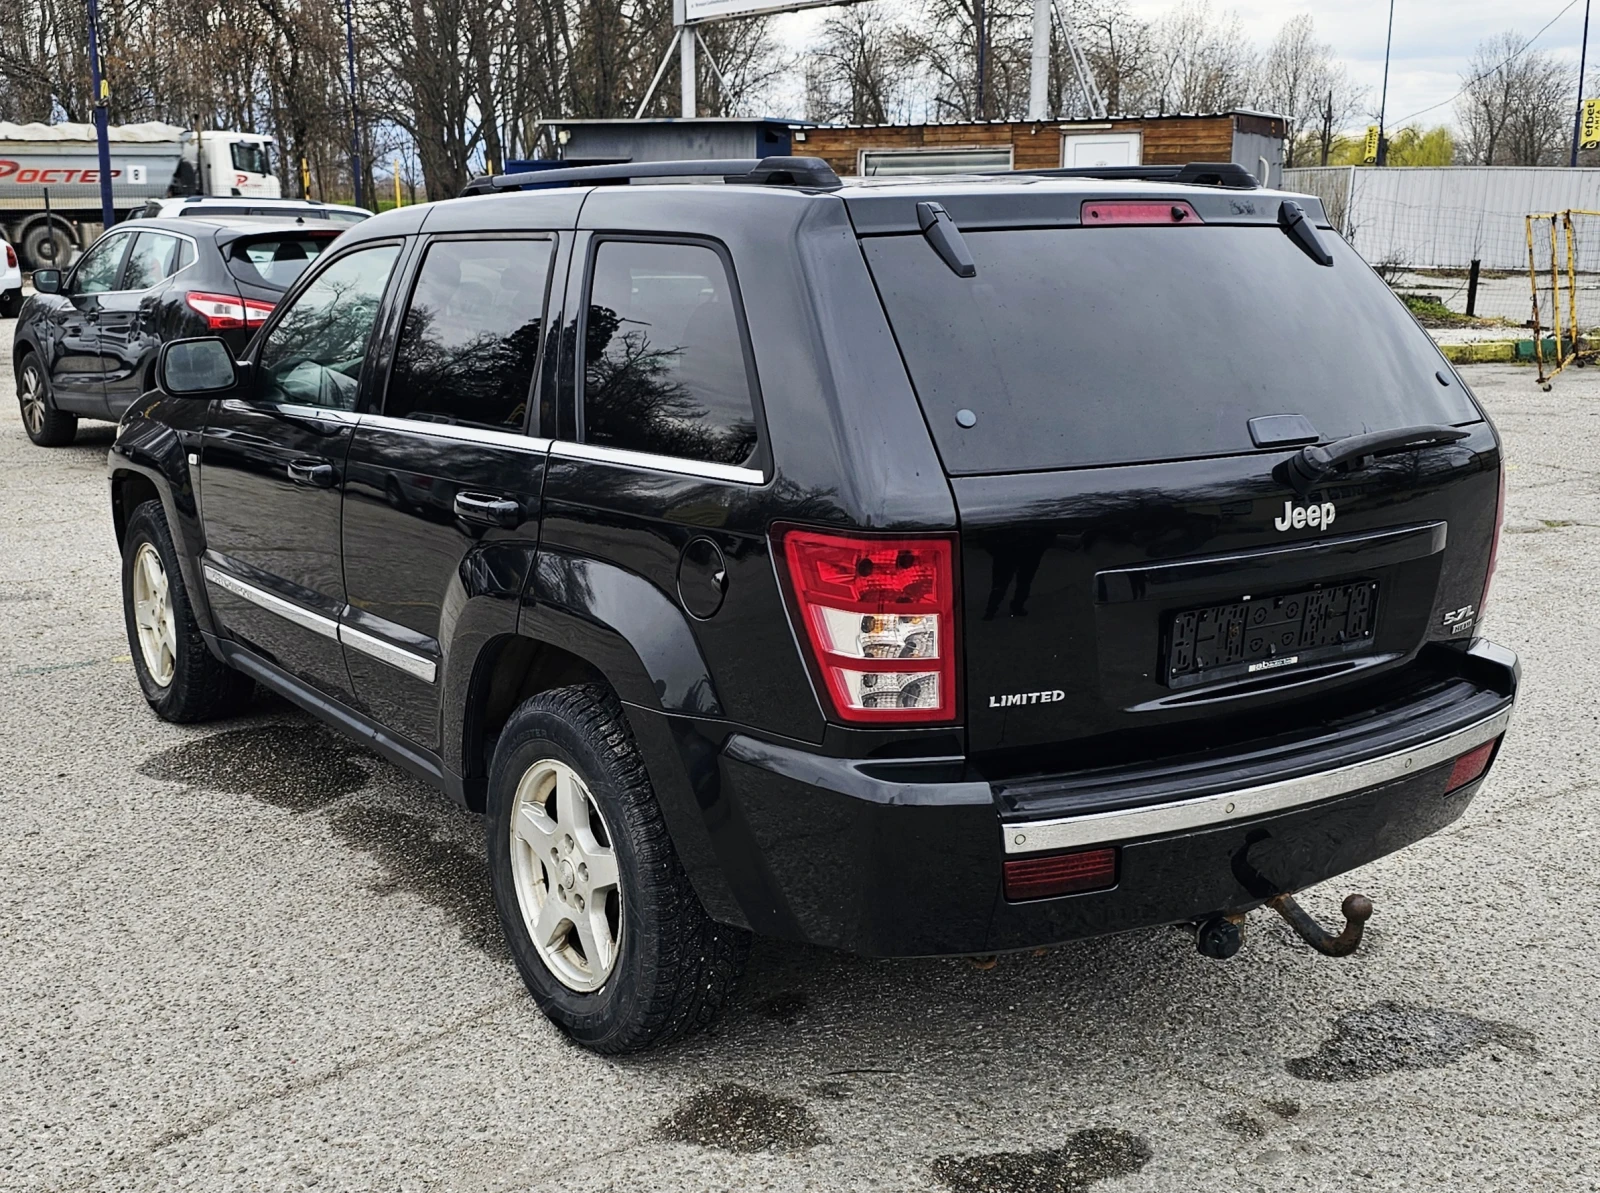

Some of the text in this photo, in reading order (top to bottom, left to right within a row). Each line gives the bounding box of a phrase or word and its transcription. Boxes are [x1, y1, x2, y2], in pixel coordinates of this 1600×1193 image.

[1584, 102, 1595, 138] efbet
[1275, 501, 1336, 532] Jeep
[989, 690, 1065, 708] LIMITED
